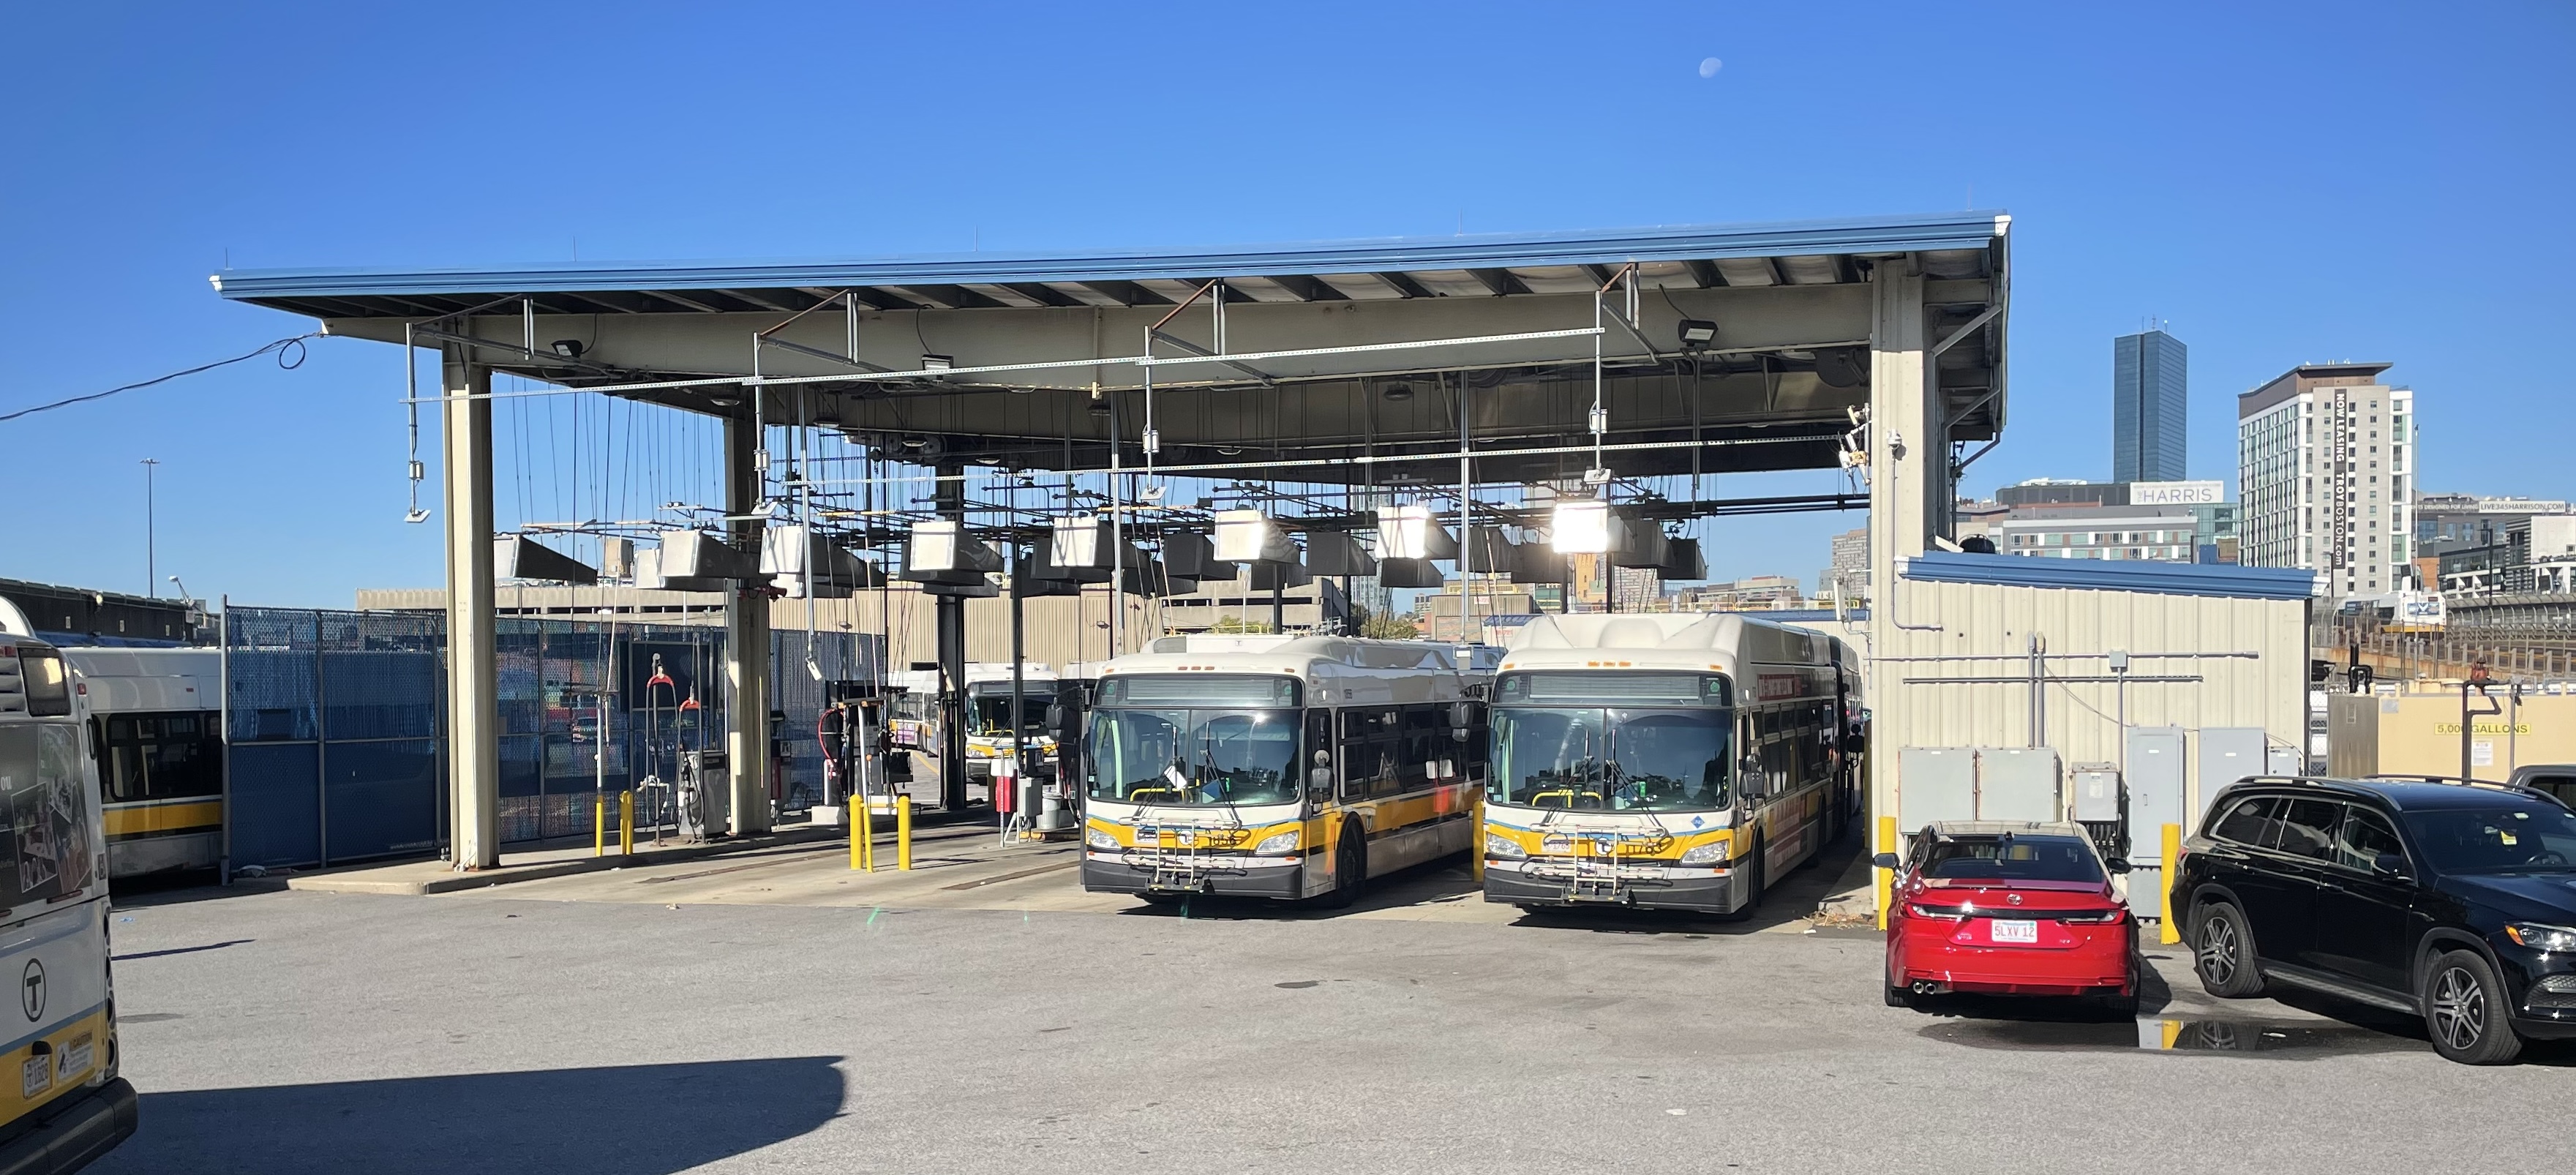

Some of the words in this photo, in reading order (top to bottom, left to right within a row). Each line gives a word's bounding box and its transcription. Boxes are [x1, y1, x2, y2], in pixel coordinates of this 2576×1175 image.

[2336, 393, 2345, 416] NOW
[2336, 417, 2345, 462] LEASING
[2144, 489, 2212, 503] HARRIS
[2335, 473, 2345, 566] TROYBOSTON.com
[2438, 725, 2463, 734] 5,00
[2471, 724, 2528, 733] GALLONS
[1994, 925, 2019, 937] 5LXV
[2023, 926, 2035, 937] 12
